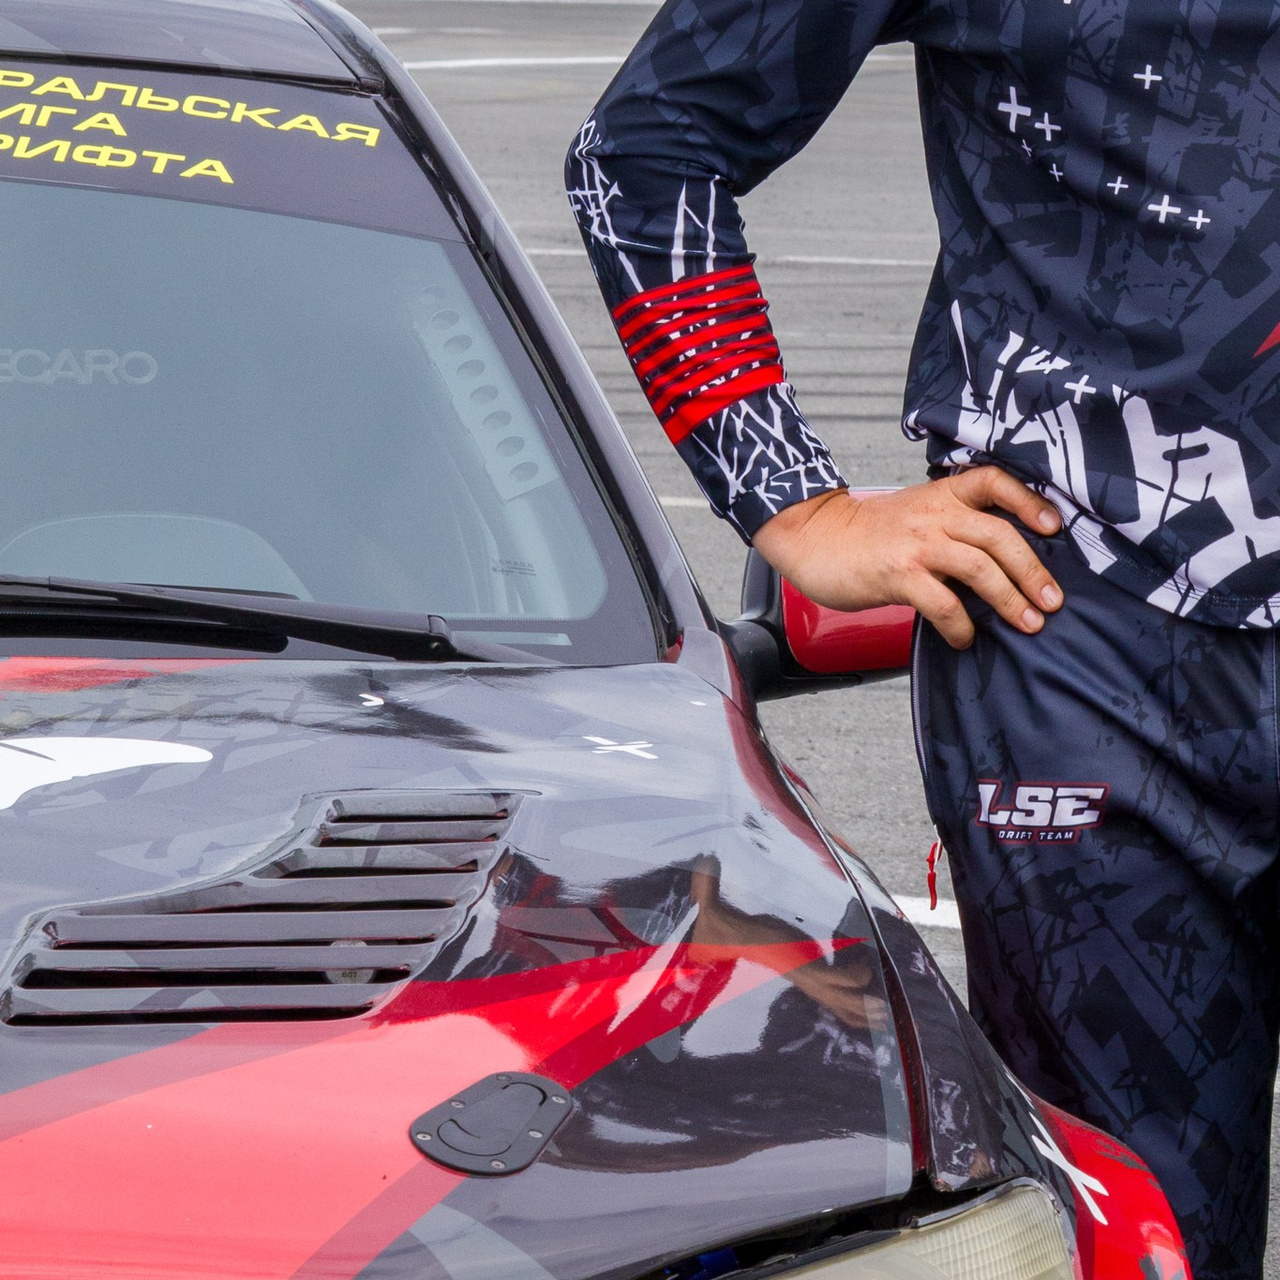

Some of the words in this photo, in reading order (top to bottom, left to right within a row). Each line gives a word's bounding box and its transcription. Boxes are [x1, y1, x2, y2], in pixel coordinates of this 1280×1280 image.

[978, 784, 1105, 826] LSE
[998, 830, 1033, 839] DRIFT
[1040, 831, 1073, 839] TEAM
